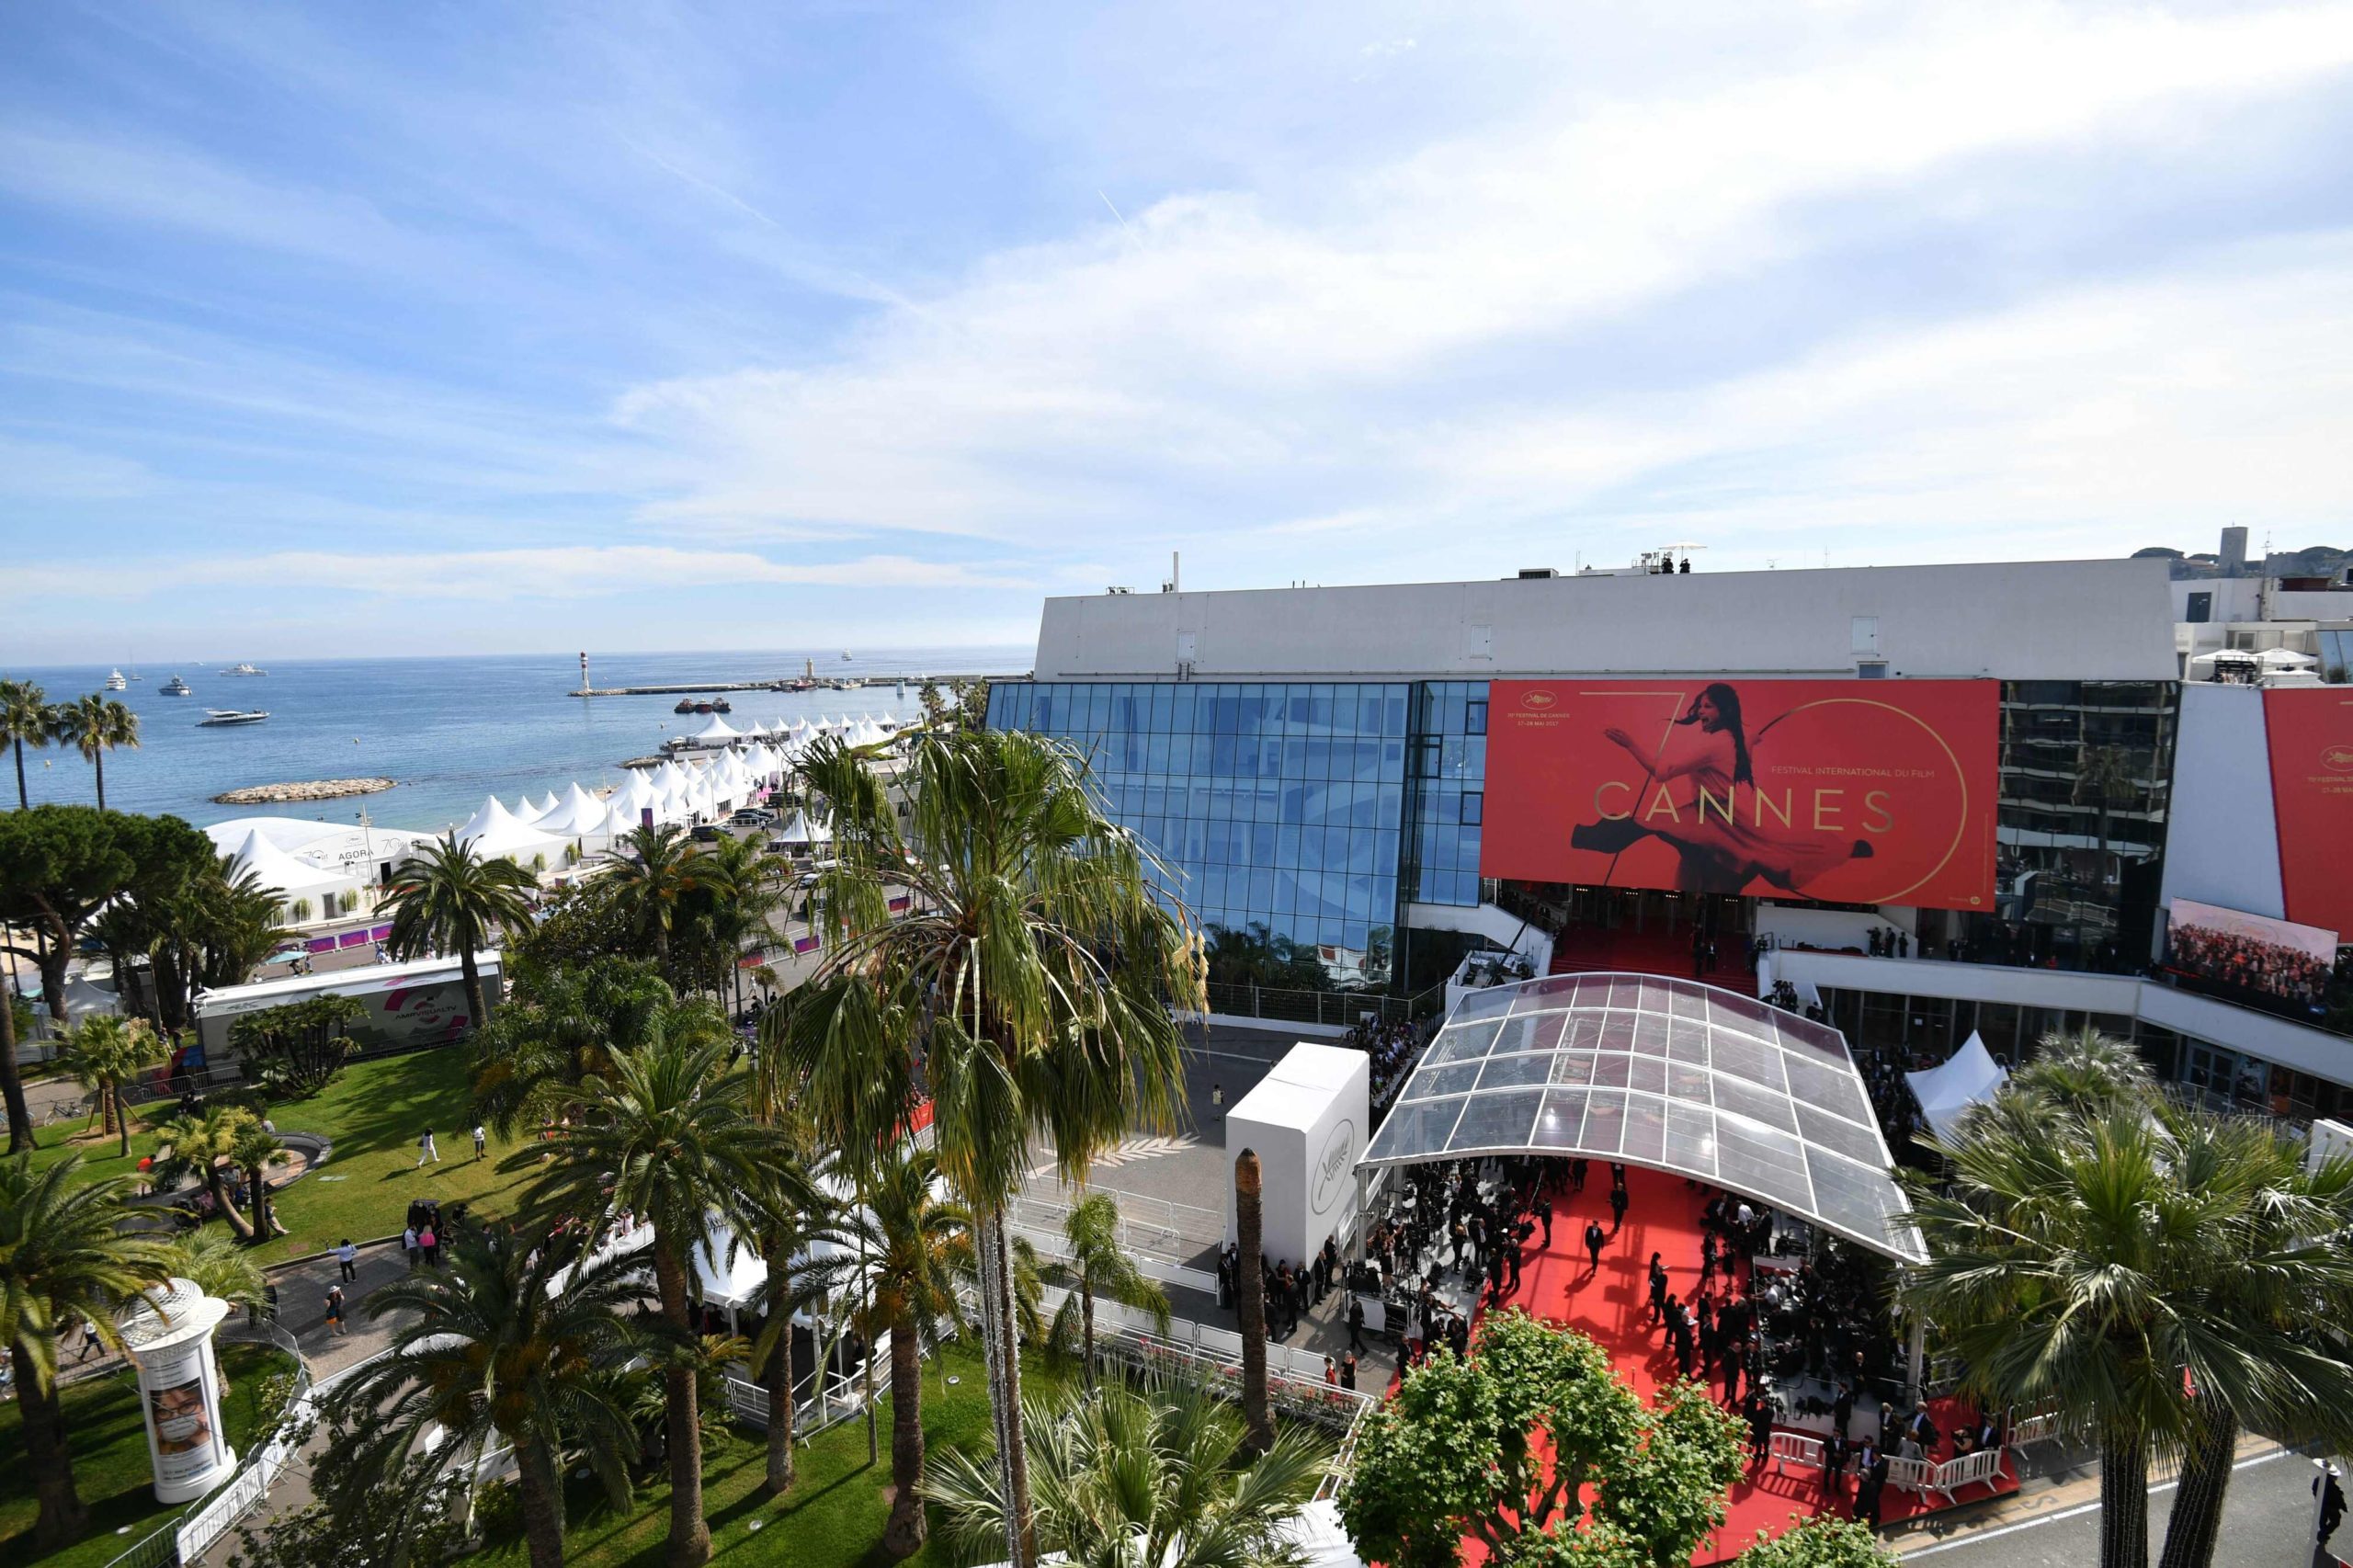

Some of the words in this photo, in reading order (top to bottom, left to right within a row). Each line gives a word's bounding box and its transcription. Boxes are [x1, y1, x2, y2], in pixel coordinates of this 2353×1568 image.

[1771, 765, 1813, 775] FESTIVAL
[1815, 766, 1893, 778] INTERNATIONAL
[1895, 768, 1909, 778] DU
[1911, 769, 1934, 778] FILM
[1594, 781, 1894, 833] CANNES
[338, 848, 374, 860] AGORA
[143, 1342, 190, 1360] CANNES
